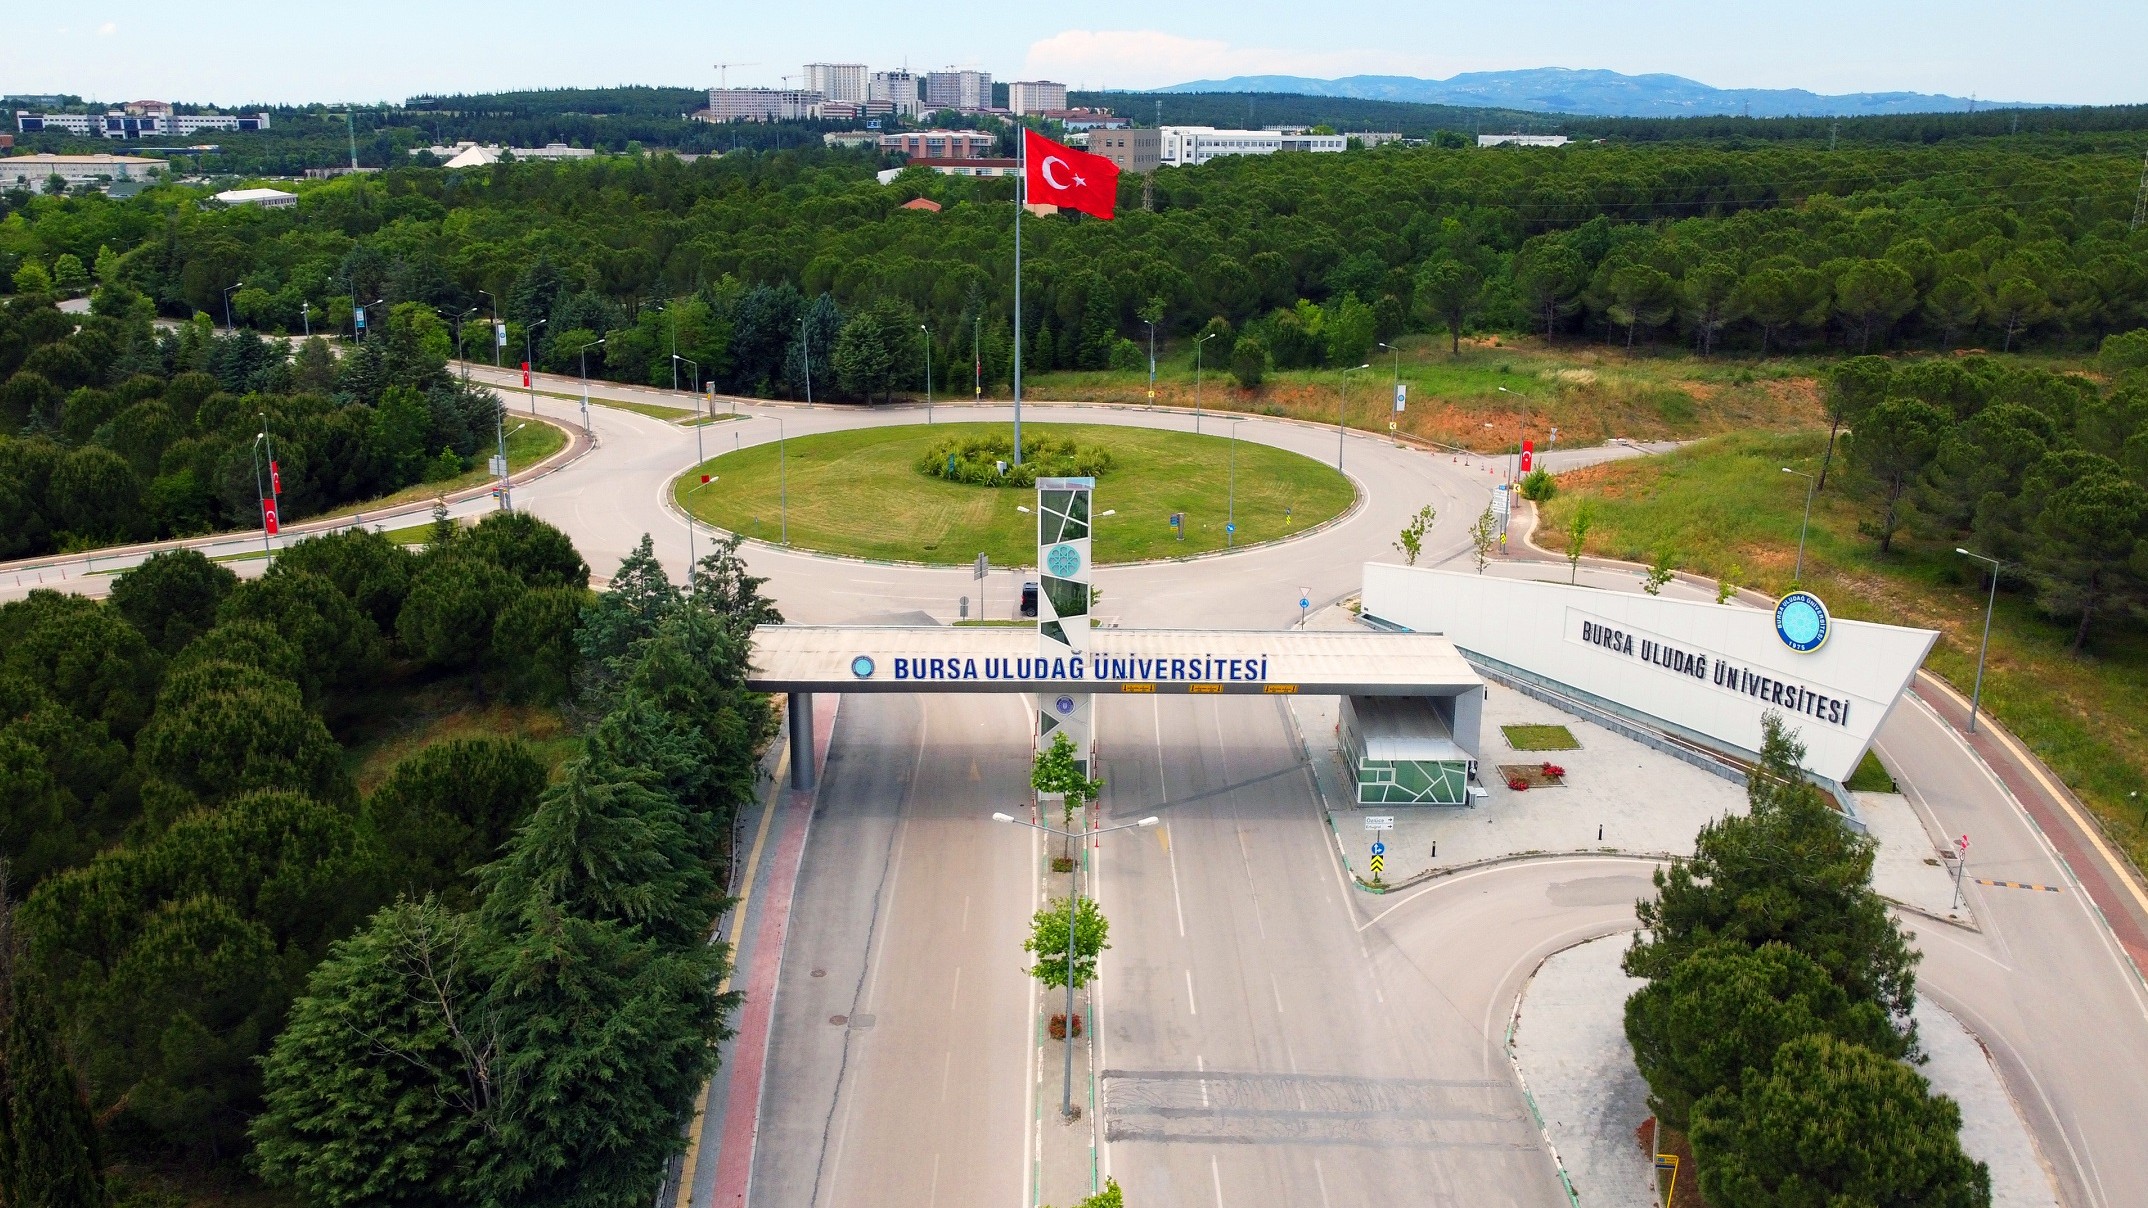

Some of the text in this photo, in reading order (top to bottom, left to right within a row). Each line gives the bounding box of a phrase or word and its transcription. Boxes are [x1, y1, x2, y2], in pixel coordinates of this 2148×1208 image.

[1776, 606, 1784, 629] BURSA
[895, 658, 978, 679] BURSA
[985, 650, 1083, 679] ULUDAĞ
[1095, 652, 1267, 680] ÜNİVERSİTESİ
[1582, 620, 1850, 727] BURSA ULUDAĞ ÜNİVERSİTESİ
